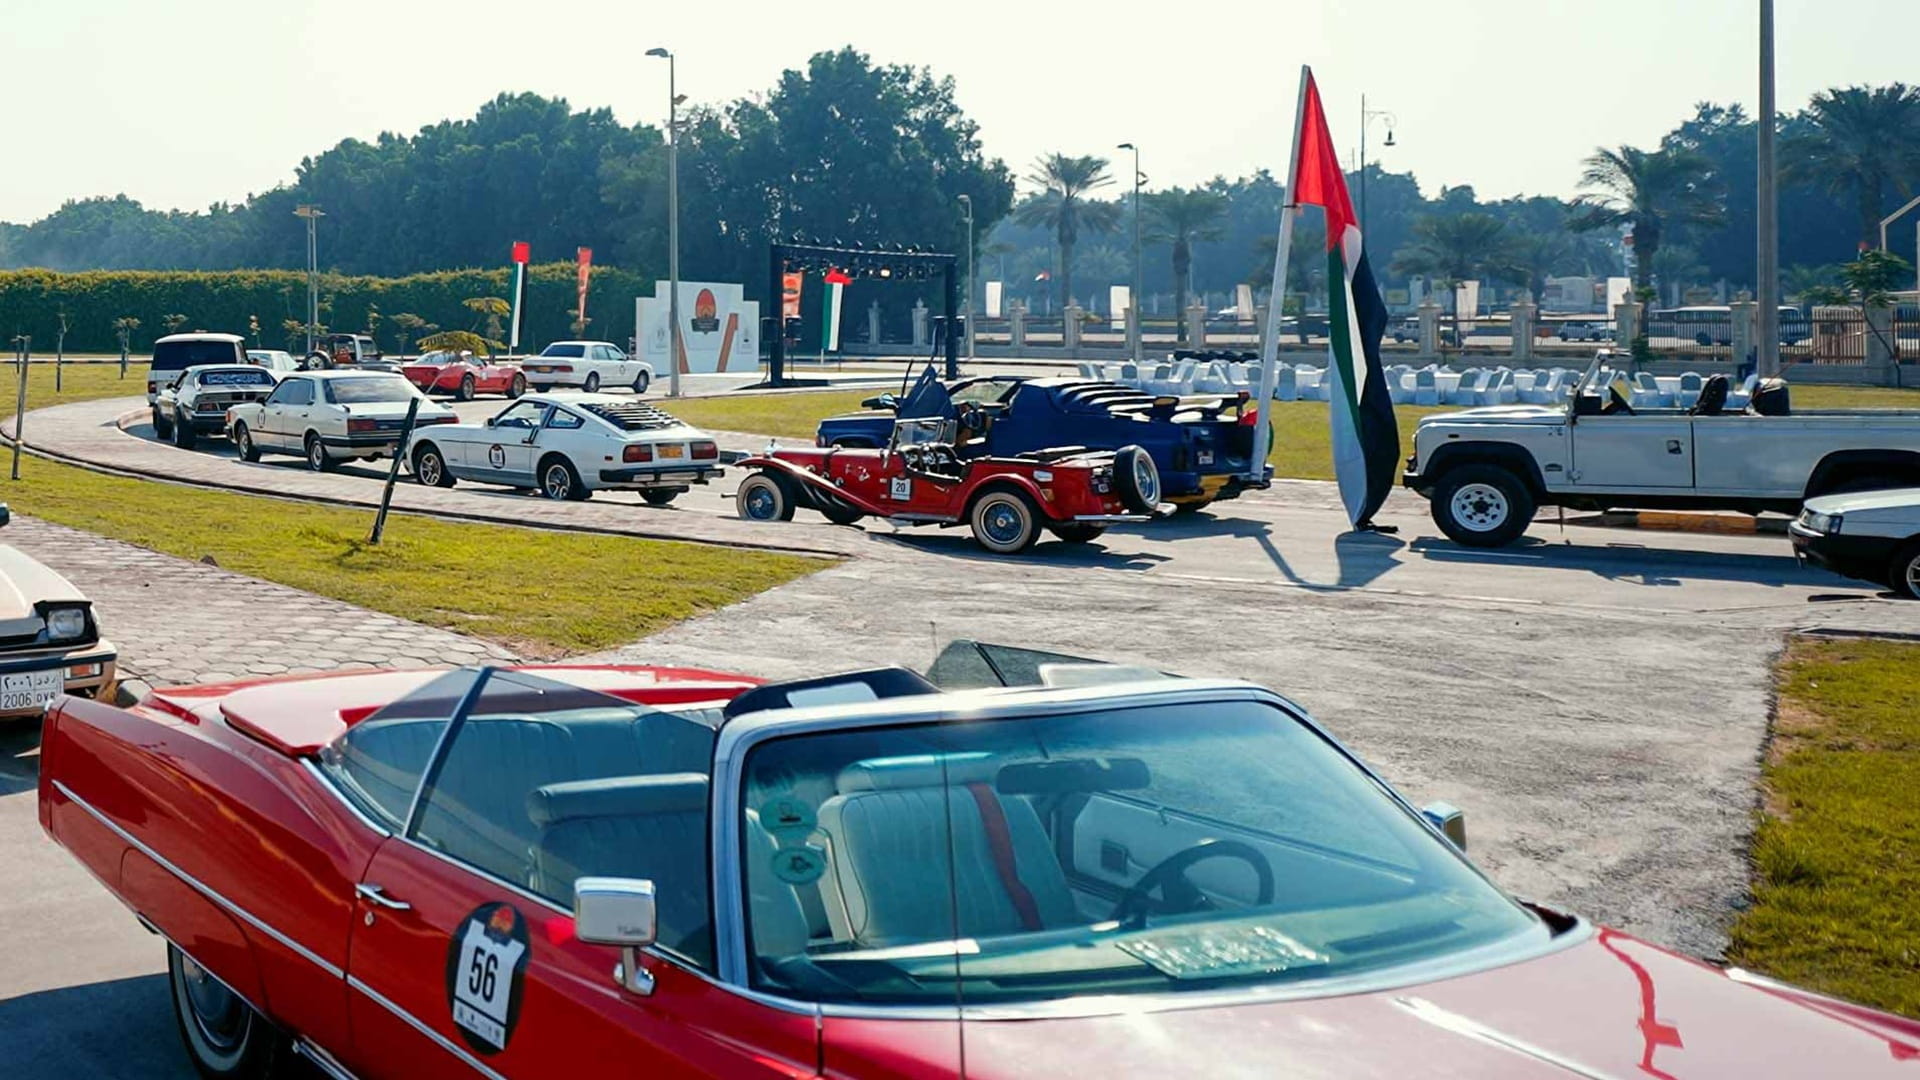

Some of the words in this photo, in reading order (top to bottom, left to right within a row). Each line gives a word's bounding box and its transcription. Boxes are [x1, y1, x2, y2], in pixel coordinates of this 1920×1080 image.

[895, 481, 906, 493] 20
[4, 692, 32, 708] 2006
[469, 945, 498, 1003] 56
